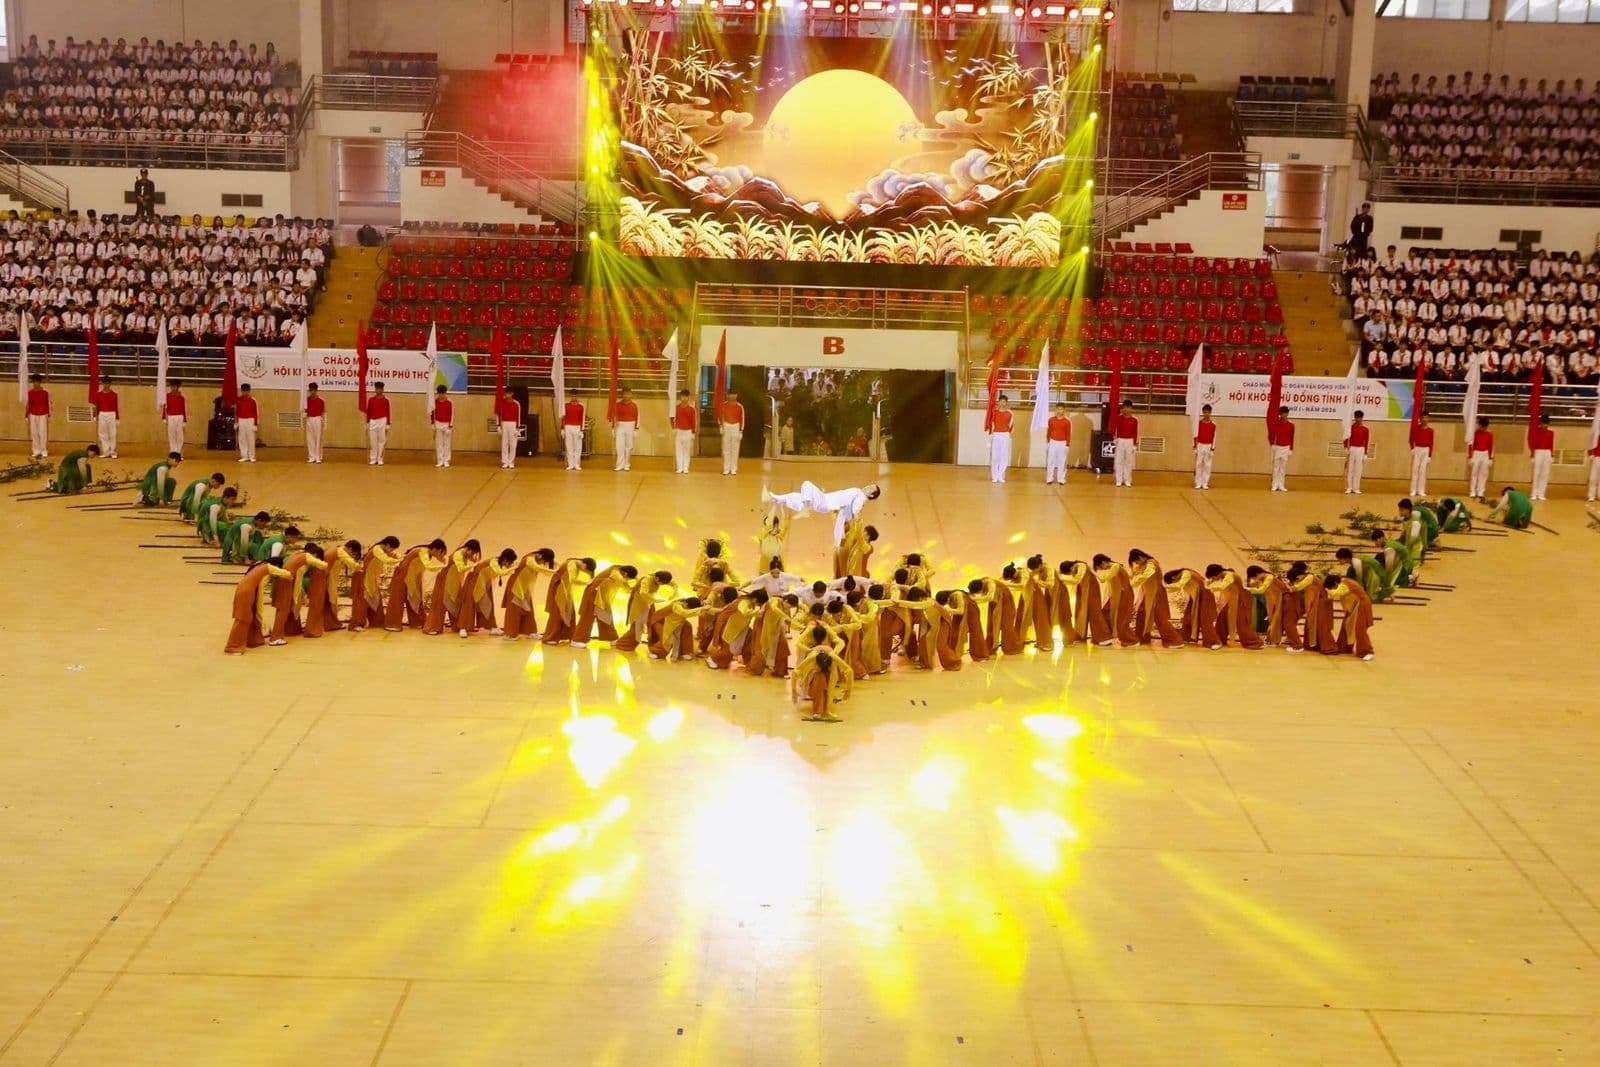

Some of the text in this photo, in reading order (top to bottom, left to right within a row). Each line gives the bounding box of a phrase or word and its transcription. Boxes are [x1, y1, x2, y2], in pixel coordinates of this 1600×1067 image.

[823, 336, 845, 355] B
[273, 365, 290, 378] HỘI
[392, 368, 411, 379] PHÚ
[1229, 390, 1245, 403] HỘI
[1293, 390, 1320, 403] ĐỔNG
[1363, 395, 1381, 408] THỌ
